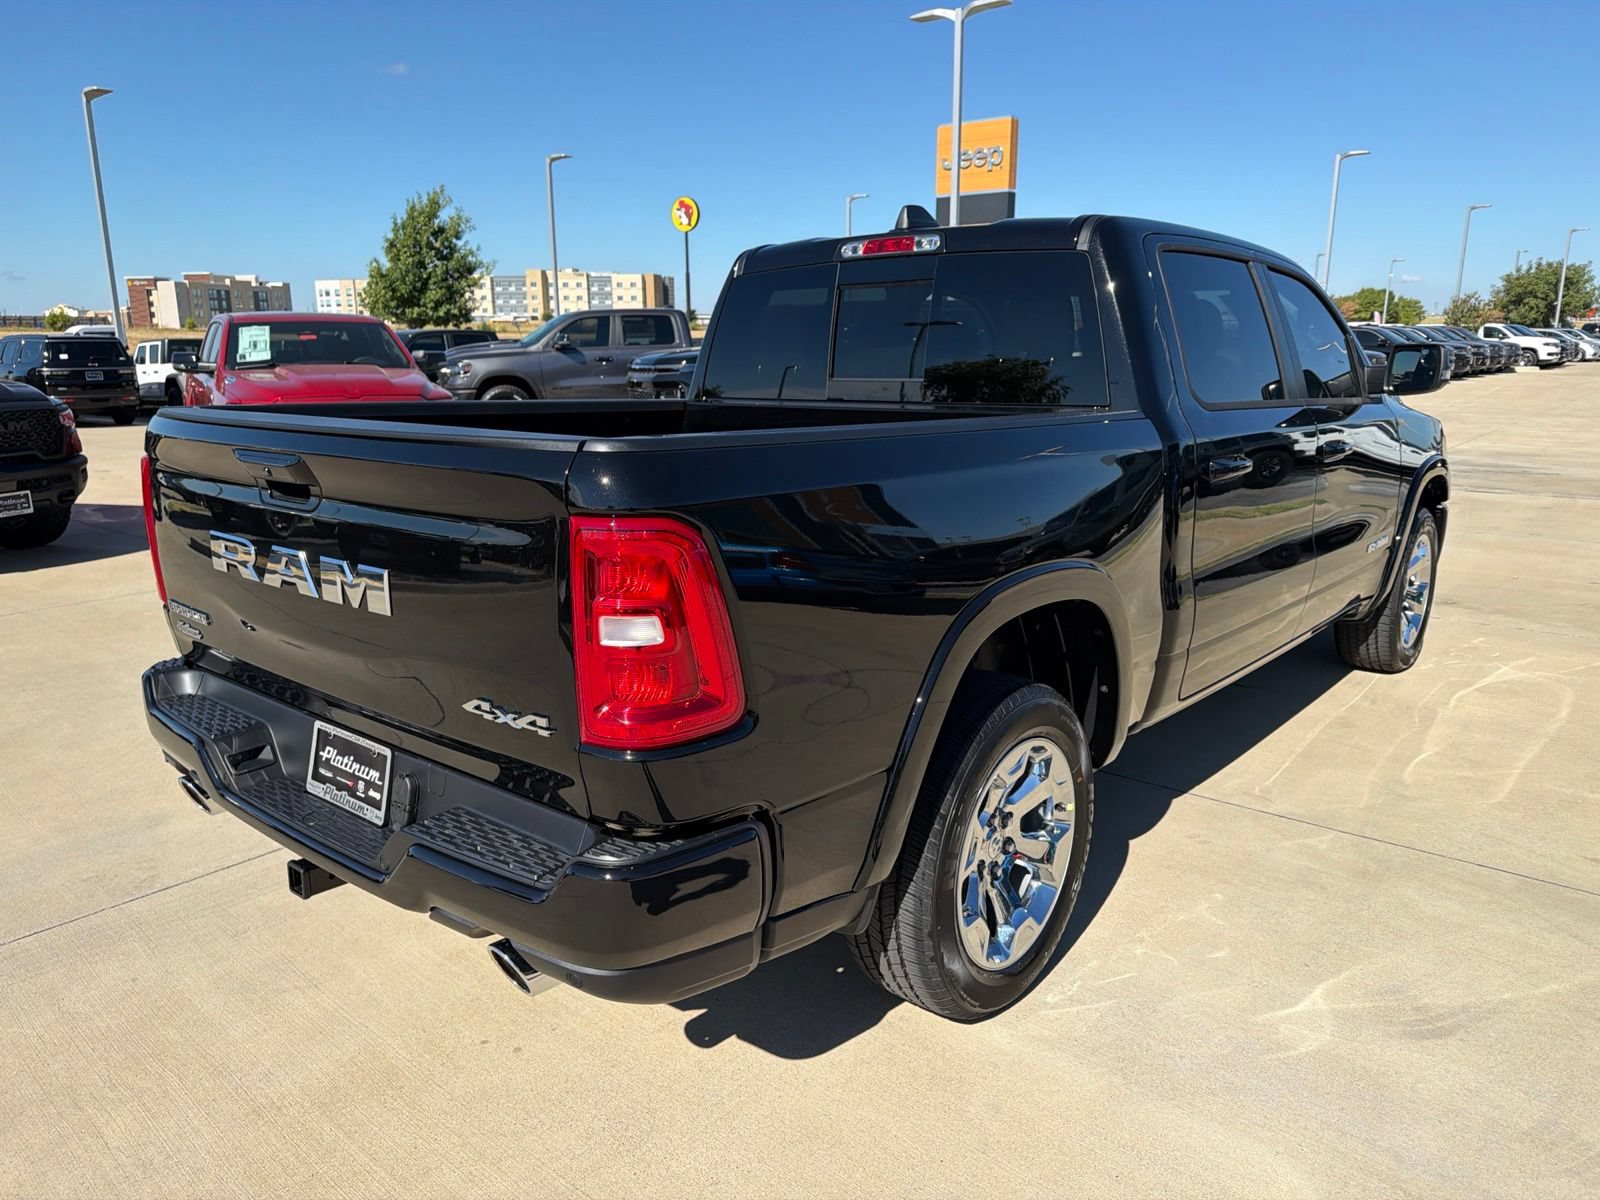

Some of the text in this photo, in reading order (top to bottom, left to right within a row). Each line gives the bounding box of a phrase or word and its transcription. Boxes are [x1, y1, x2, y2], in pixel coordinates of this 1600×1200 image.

[209, 529, 393, 617] RAM
[319, 745, 383, 785] Platinum
[323, 784, 369, 817] Platinum
